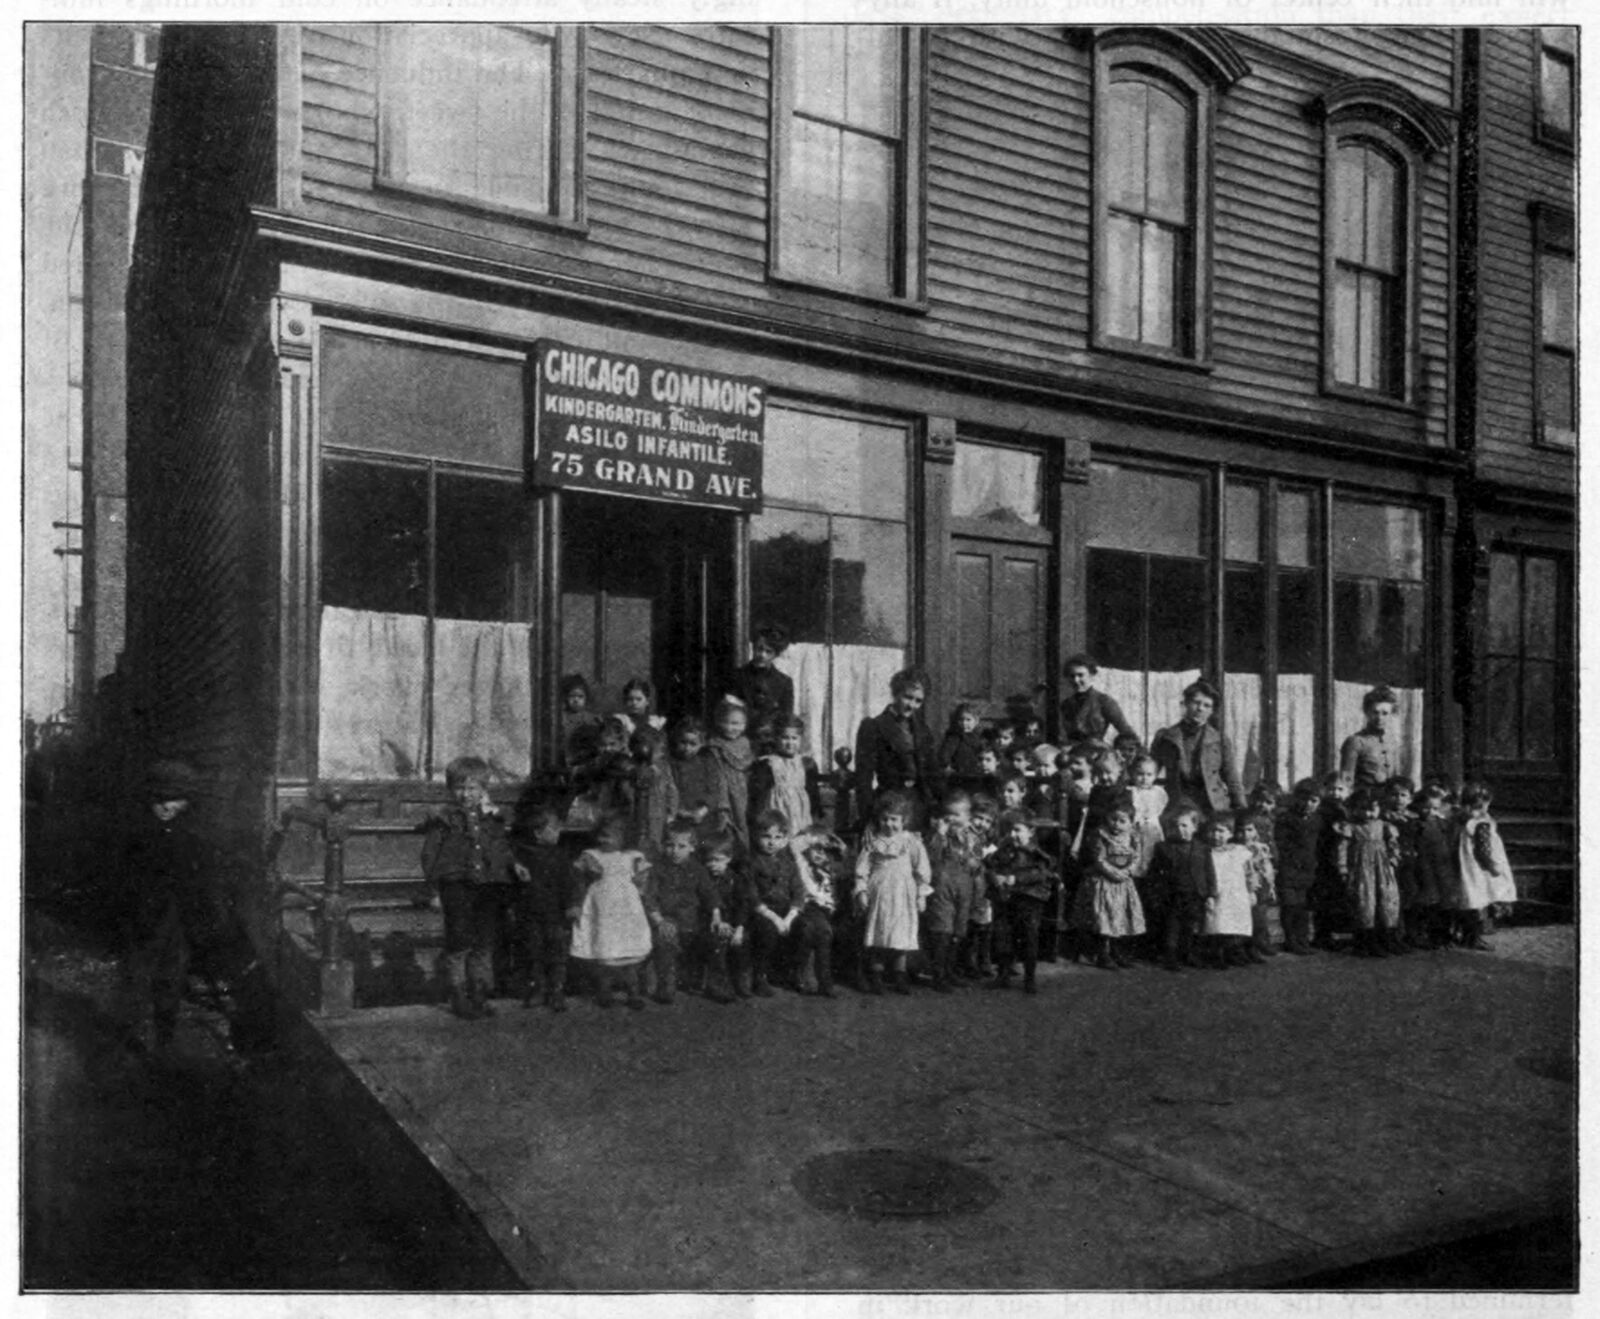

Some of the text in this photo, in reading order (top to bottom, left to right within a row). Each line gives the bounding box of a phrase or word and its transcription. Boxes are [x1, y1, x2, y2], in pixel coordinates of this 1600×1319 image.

[545, 349, 762, 417] CHICAGO COMMONS
[565, 424, 732, 466] ASILO INFANTILE.
[552, 451, 757, 499] 75 GRAND AVE.
